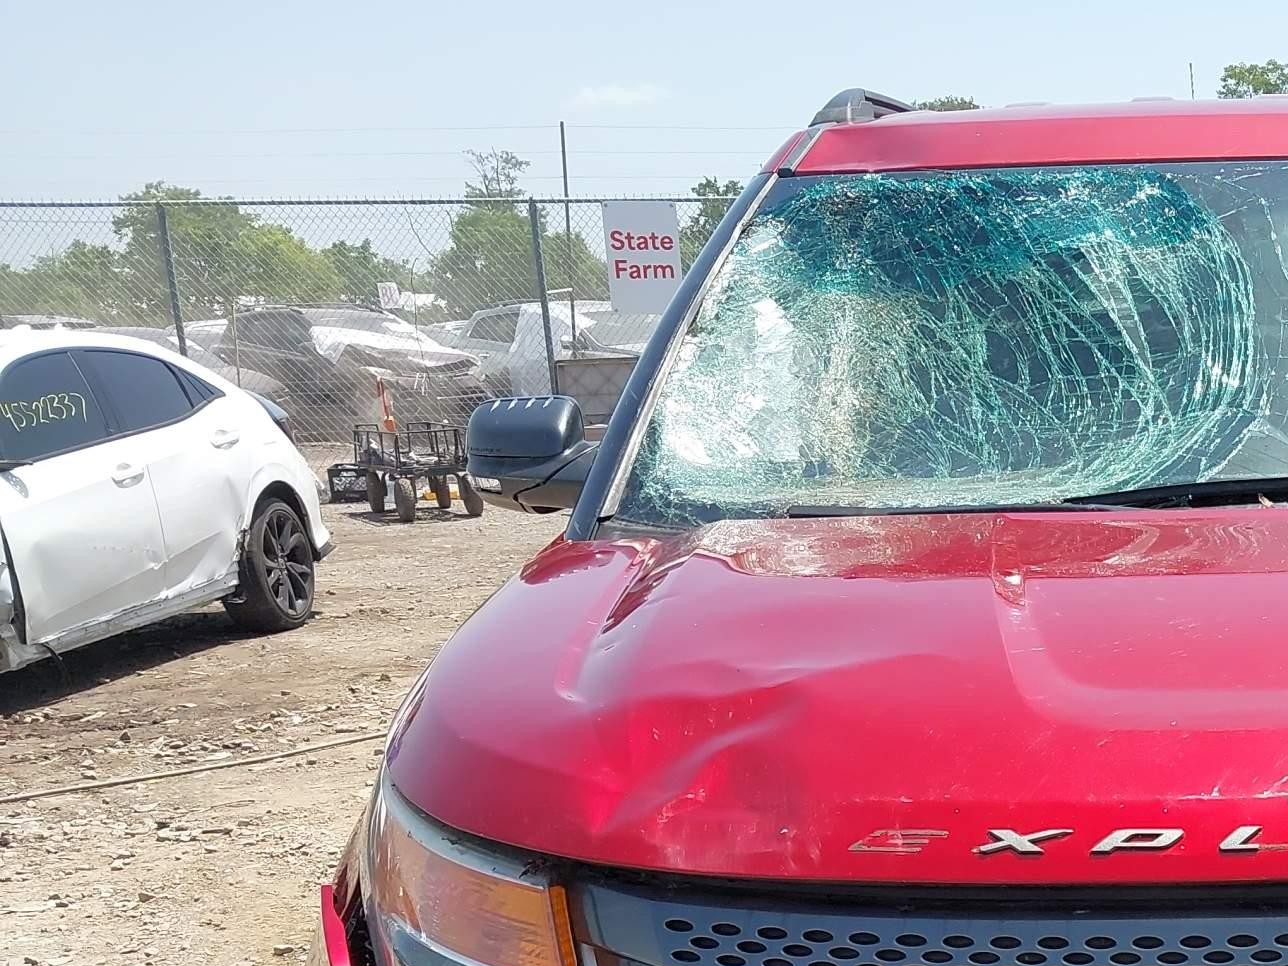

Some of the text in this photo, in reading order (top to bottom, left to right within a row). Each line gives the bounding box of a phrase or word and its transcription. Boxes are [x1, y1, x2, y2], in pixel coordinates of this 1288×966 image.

[609, 230, 674, 251] State
[614, 259, 675, 280] Farm
[0, 391, 88, 433] 45522337
